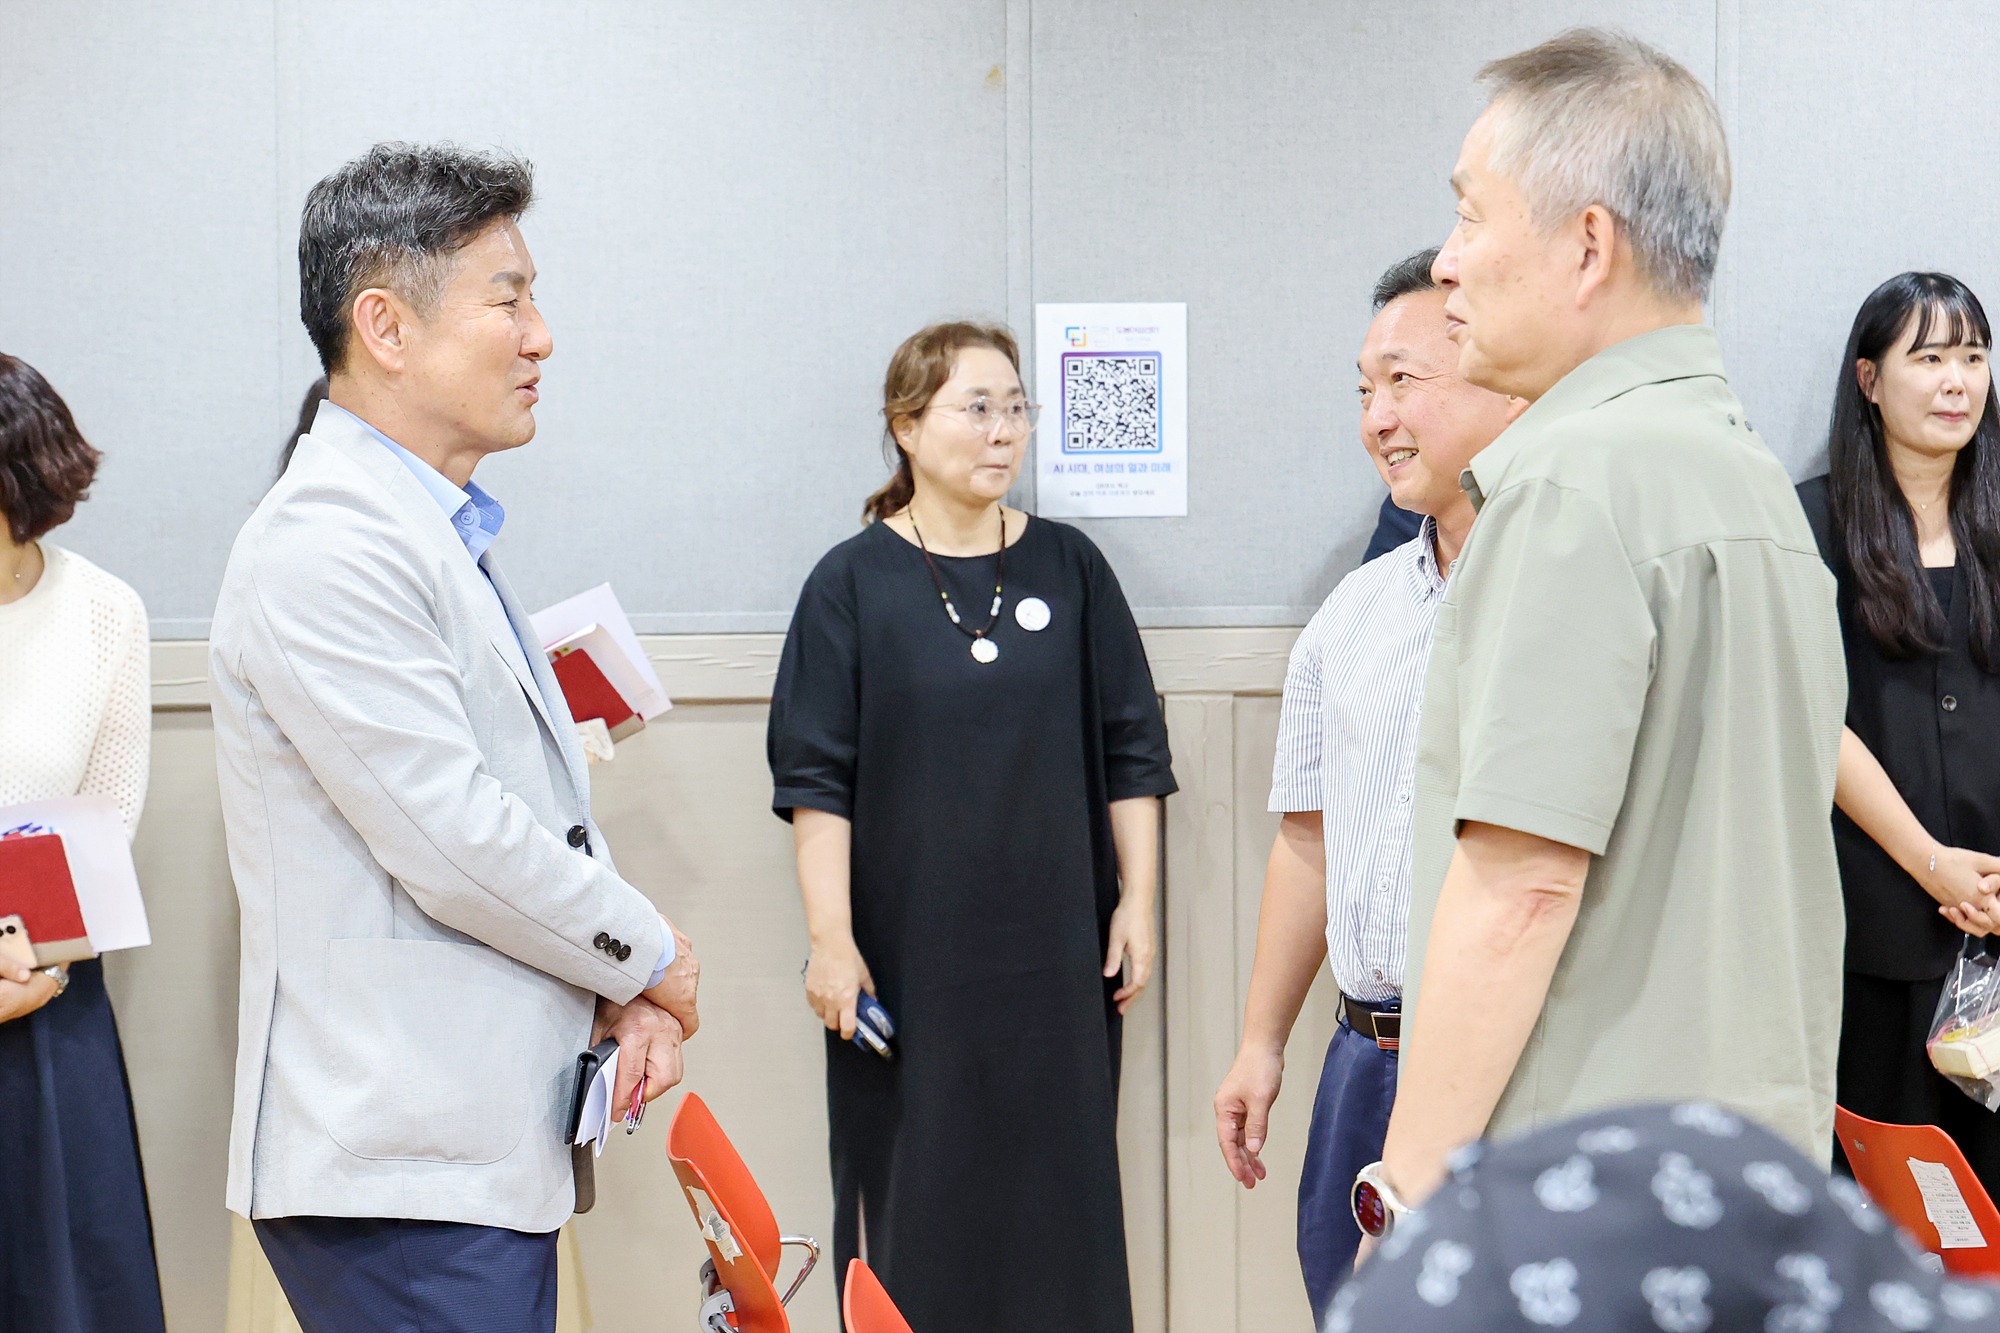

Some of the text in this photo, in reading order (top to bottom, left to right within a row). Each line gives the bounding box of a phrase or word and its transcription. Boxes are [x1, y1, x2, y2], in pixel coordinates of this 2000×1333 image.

[1053, 462, 1171, 474] AI 시대, 여성의 일과 미래
